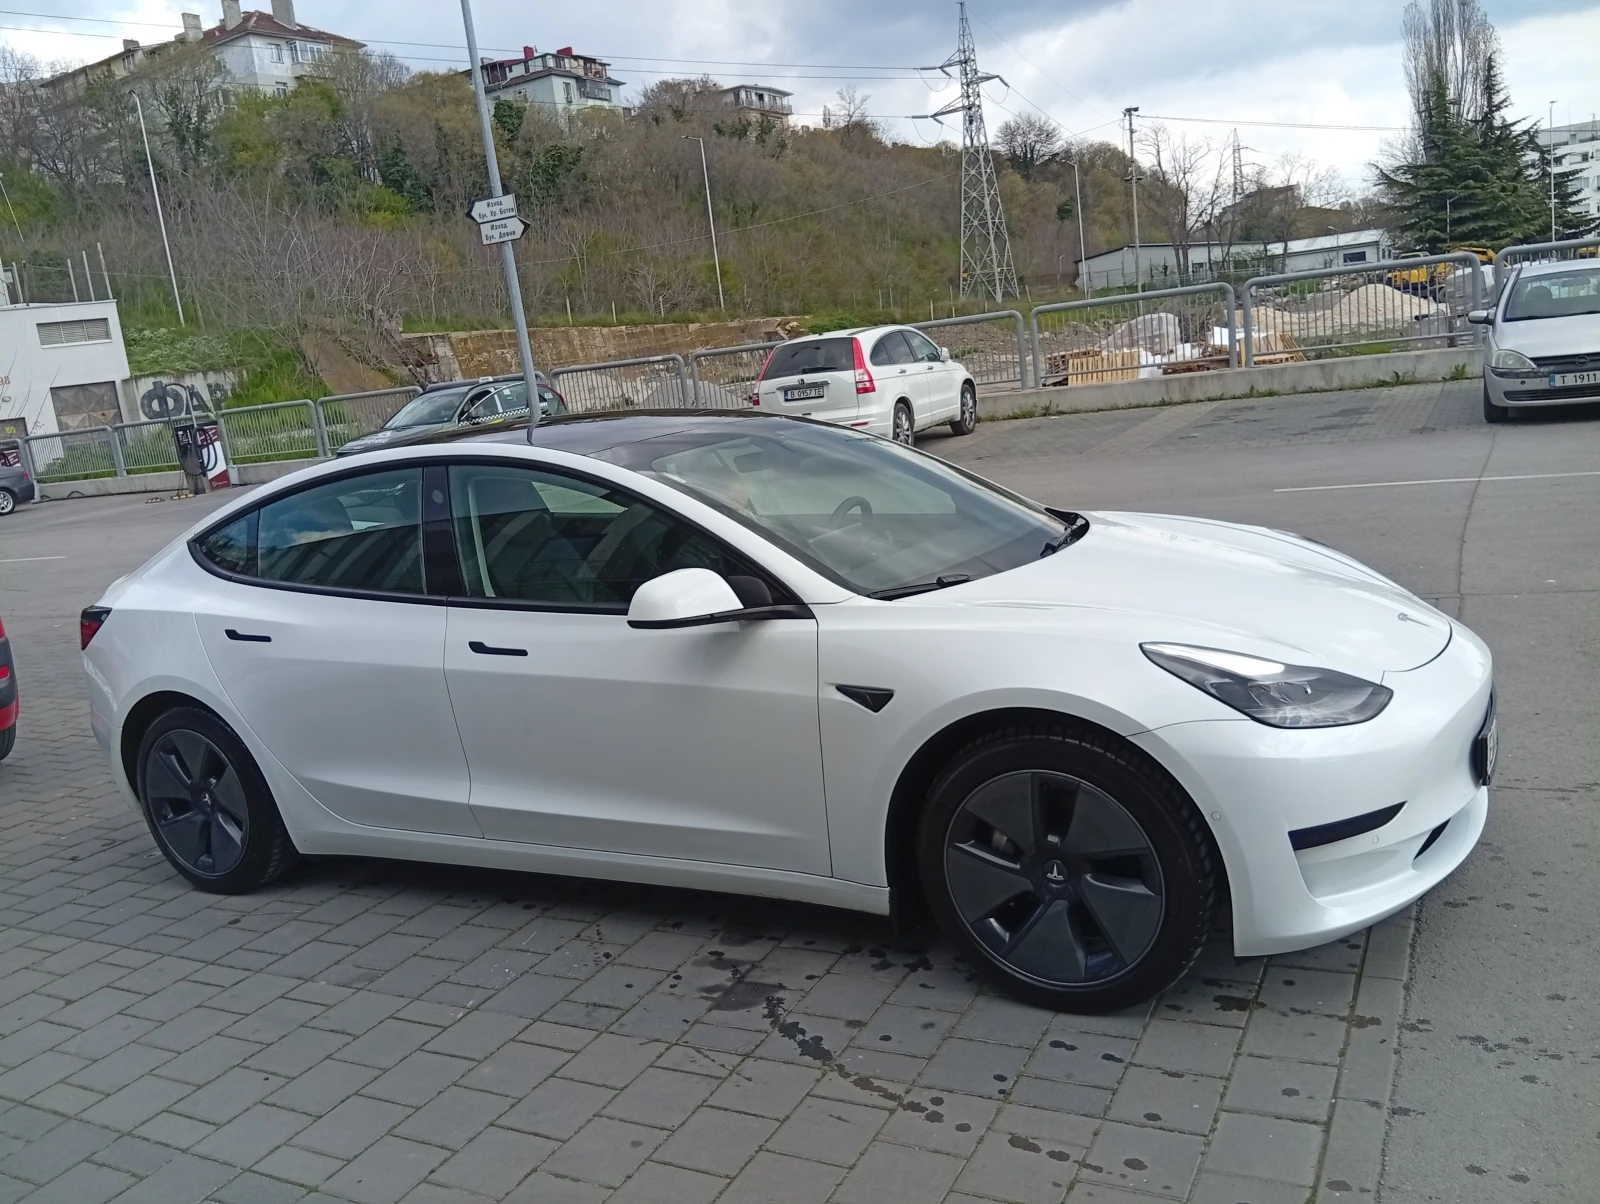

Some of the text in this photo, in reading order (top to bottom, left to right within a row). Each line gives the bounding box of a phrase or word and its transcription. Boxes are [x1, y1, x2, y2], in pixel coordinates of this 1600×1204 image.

[487, 200, 503, 208] Изход
[490, 223, 507, 231] Изход
[1560, 373, 1597, 385] T 1911
